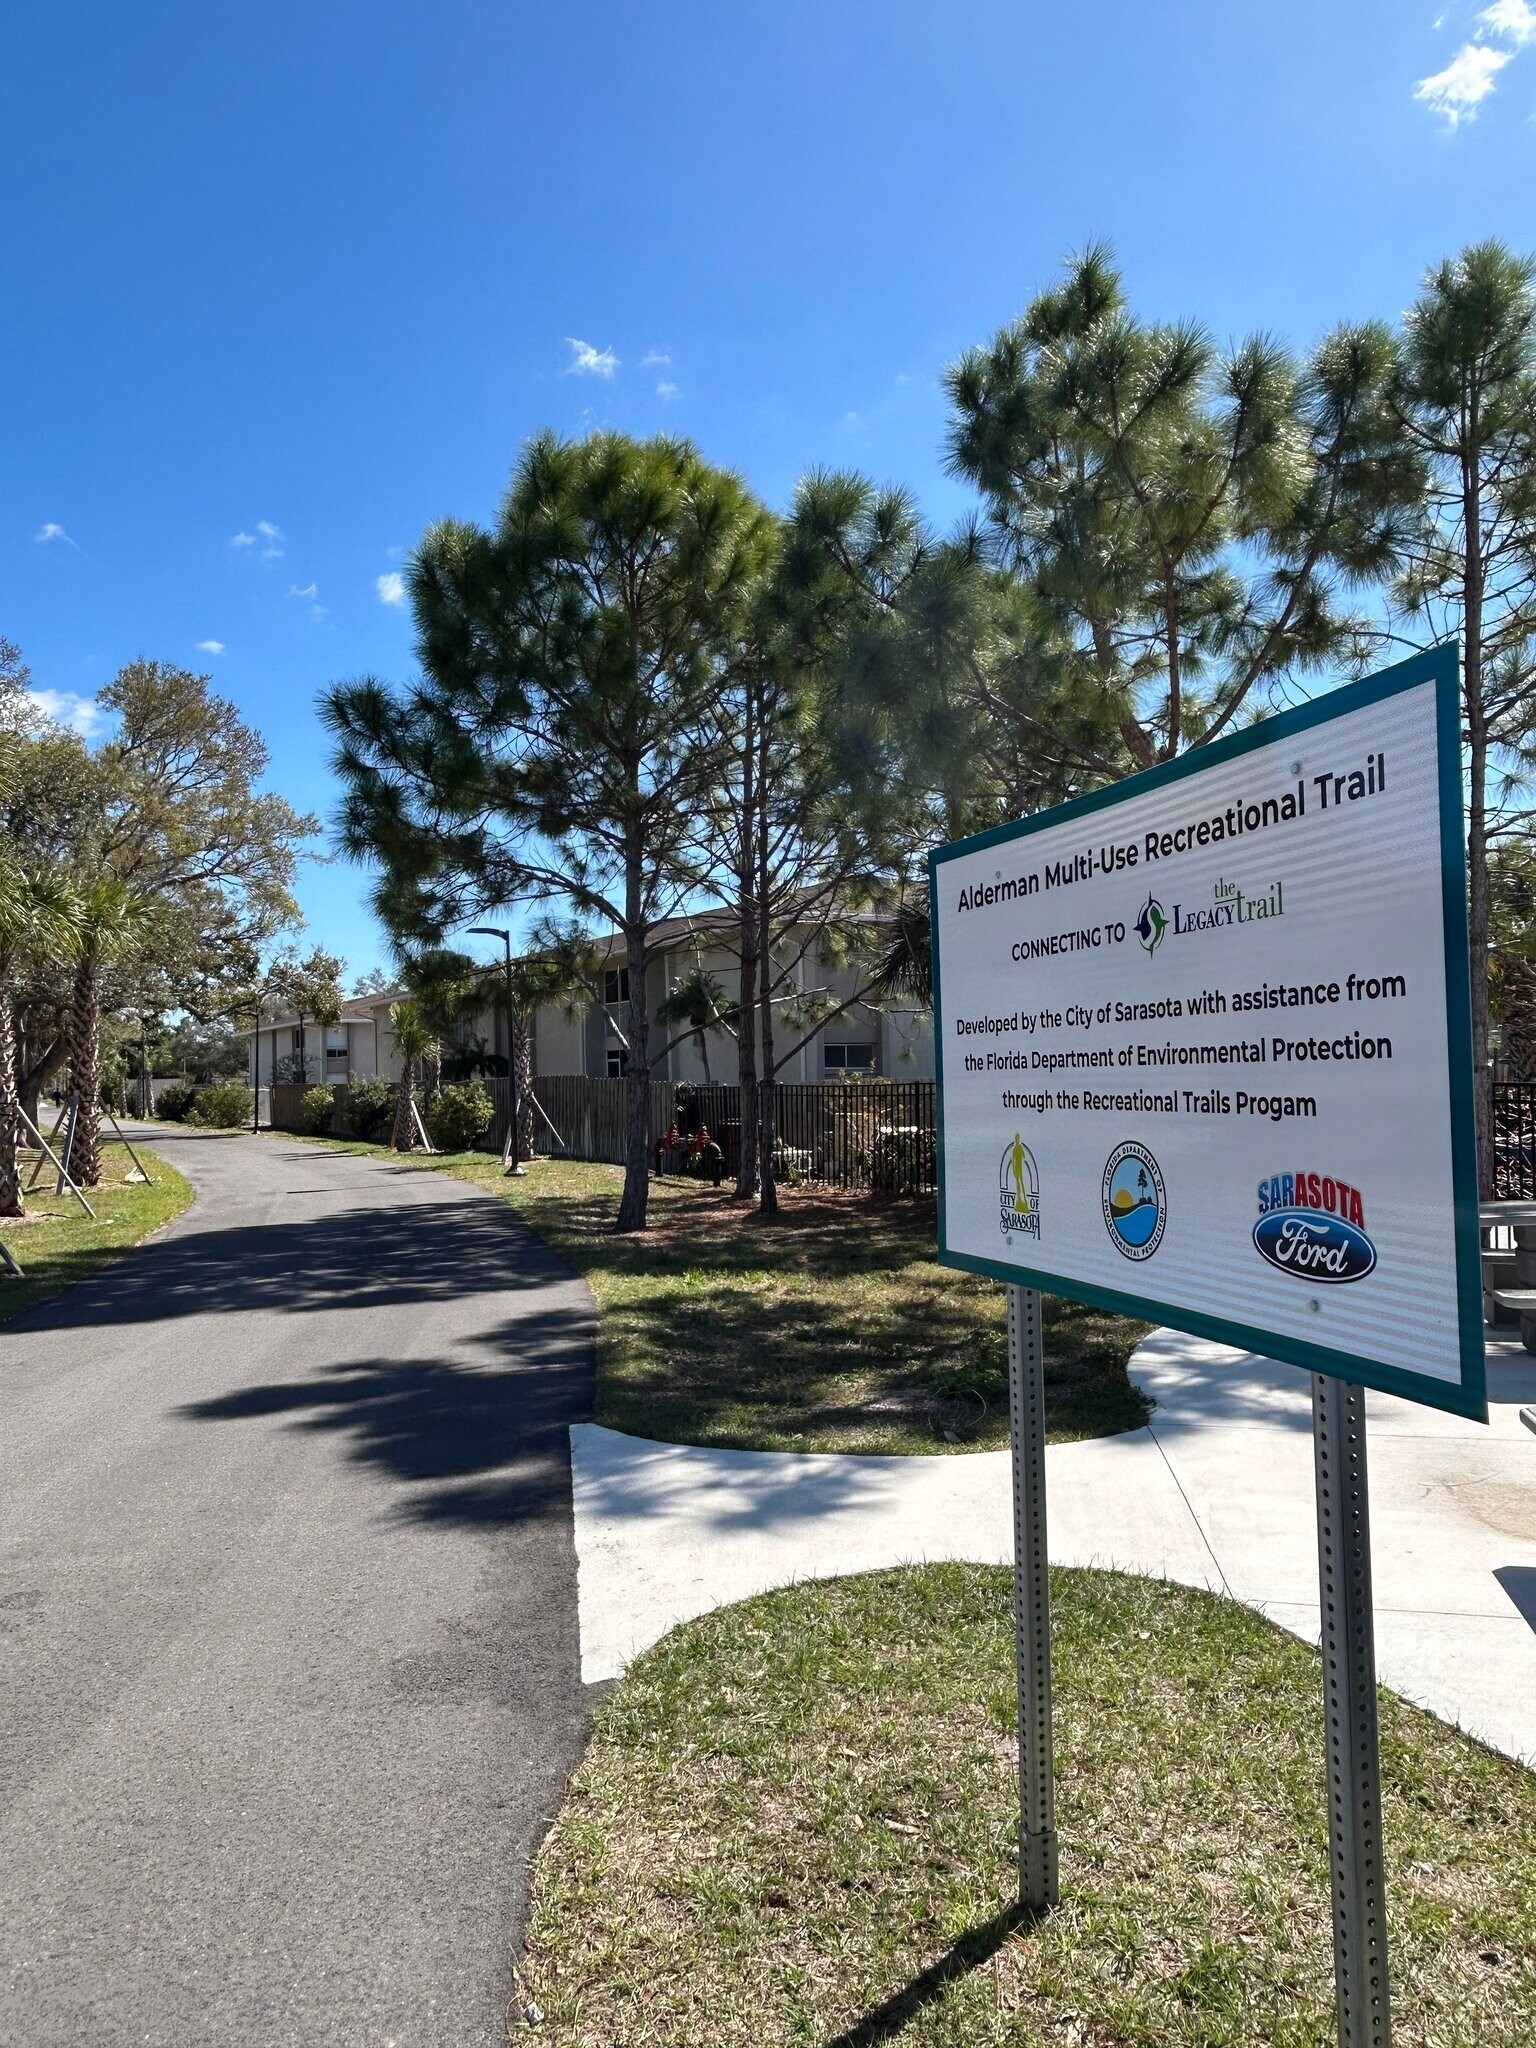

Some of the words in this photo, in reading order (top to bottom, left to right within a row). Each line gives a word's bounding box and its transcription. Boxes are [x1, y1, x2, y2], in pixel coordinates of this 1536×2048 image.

[957, 873, 1039, 913] Alderman
[1045, 842, 1139, 889] Multi-Use
[1145, 780, 1305, 862] Recreational
[1314, 753, 1386, 810] Trail
[1214, 878, 1236, 899] the
[1011, 924, 1102, 962] CONNECTING
[1104, 922, 1125, 944] TO
[956, 1012, 1018, 1036] Developed
[1021, 1012, 1037, 1034] by
[1039, 1008, 1063, 1030] the
[1065, 1005, 1092, 1029] City
[1096, 1003, 1111, 1023] of
[1114, 998, 1182, 1023] Sarasota
[1187, 990, 1227, 1016] with
[1231, 982, 1341, 1012] assistance
[1346, 972, 1407, 1002] from
[964, 1052, 984, 1072] the
[987, 1051, 1028, 1071] Florida
[1031, 1046, 1114, 1073] Department
[1118, 1046, 1134, 1066] of
[1137, 1038, 1267, 1066] Environmental
[1272, 1030, 1392, 1062] Protection
[1002, 1091, 1054, 1114] through
[1056, 1090, 1080, 1109] the
[1082, 1090, 1179, 1113] Recreational
[1182, 1090, 1231, 1114] Trails
[1235, 1091, 1317, 1122] Progam
[1000, 1194, 1015, 1208] CITY
[1030, 1196, 1039, 1210] OF
[1258, 1171, 1365, 1230] SARASOTA
[1275, 1218, 1349, 1273] Ford
